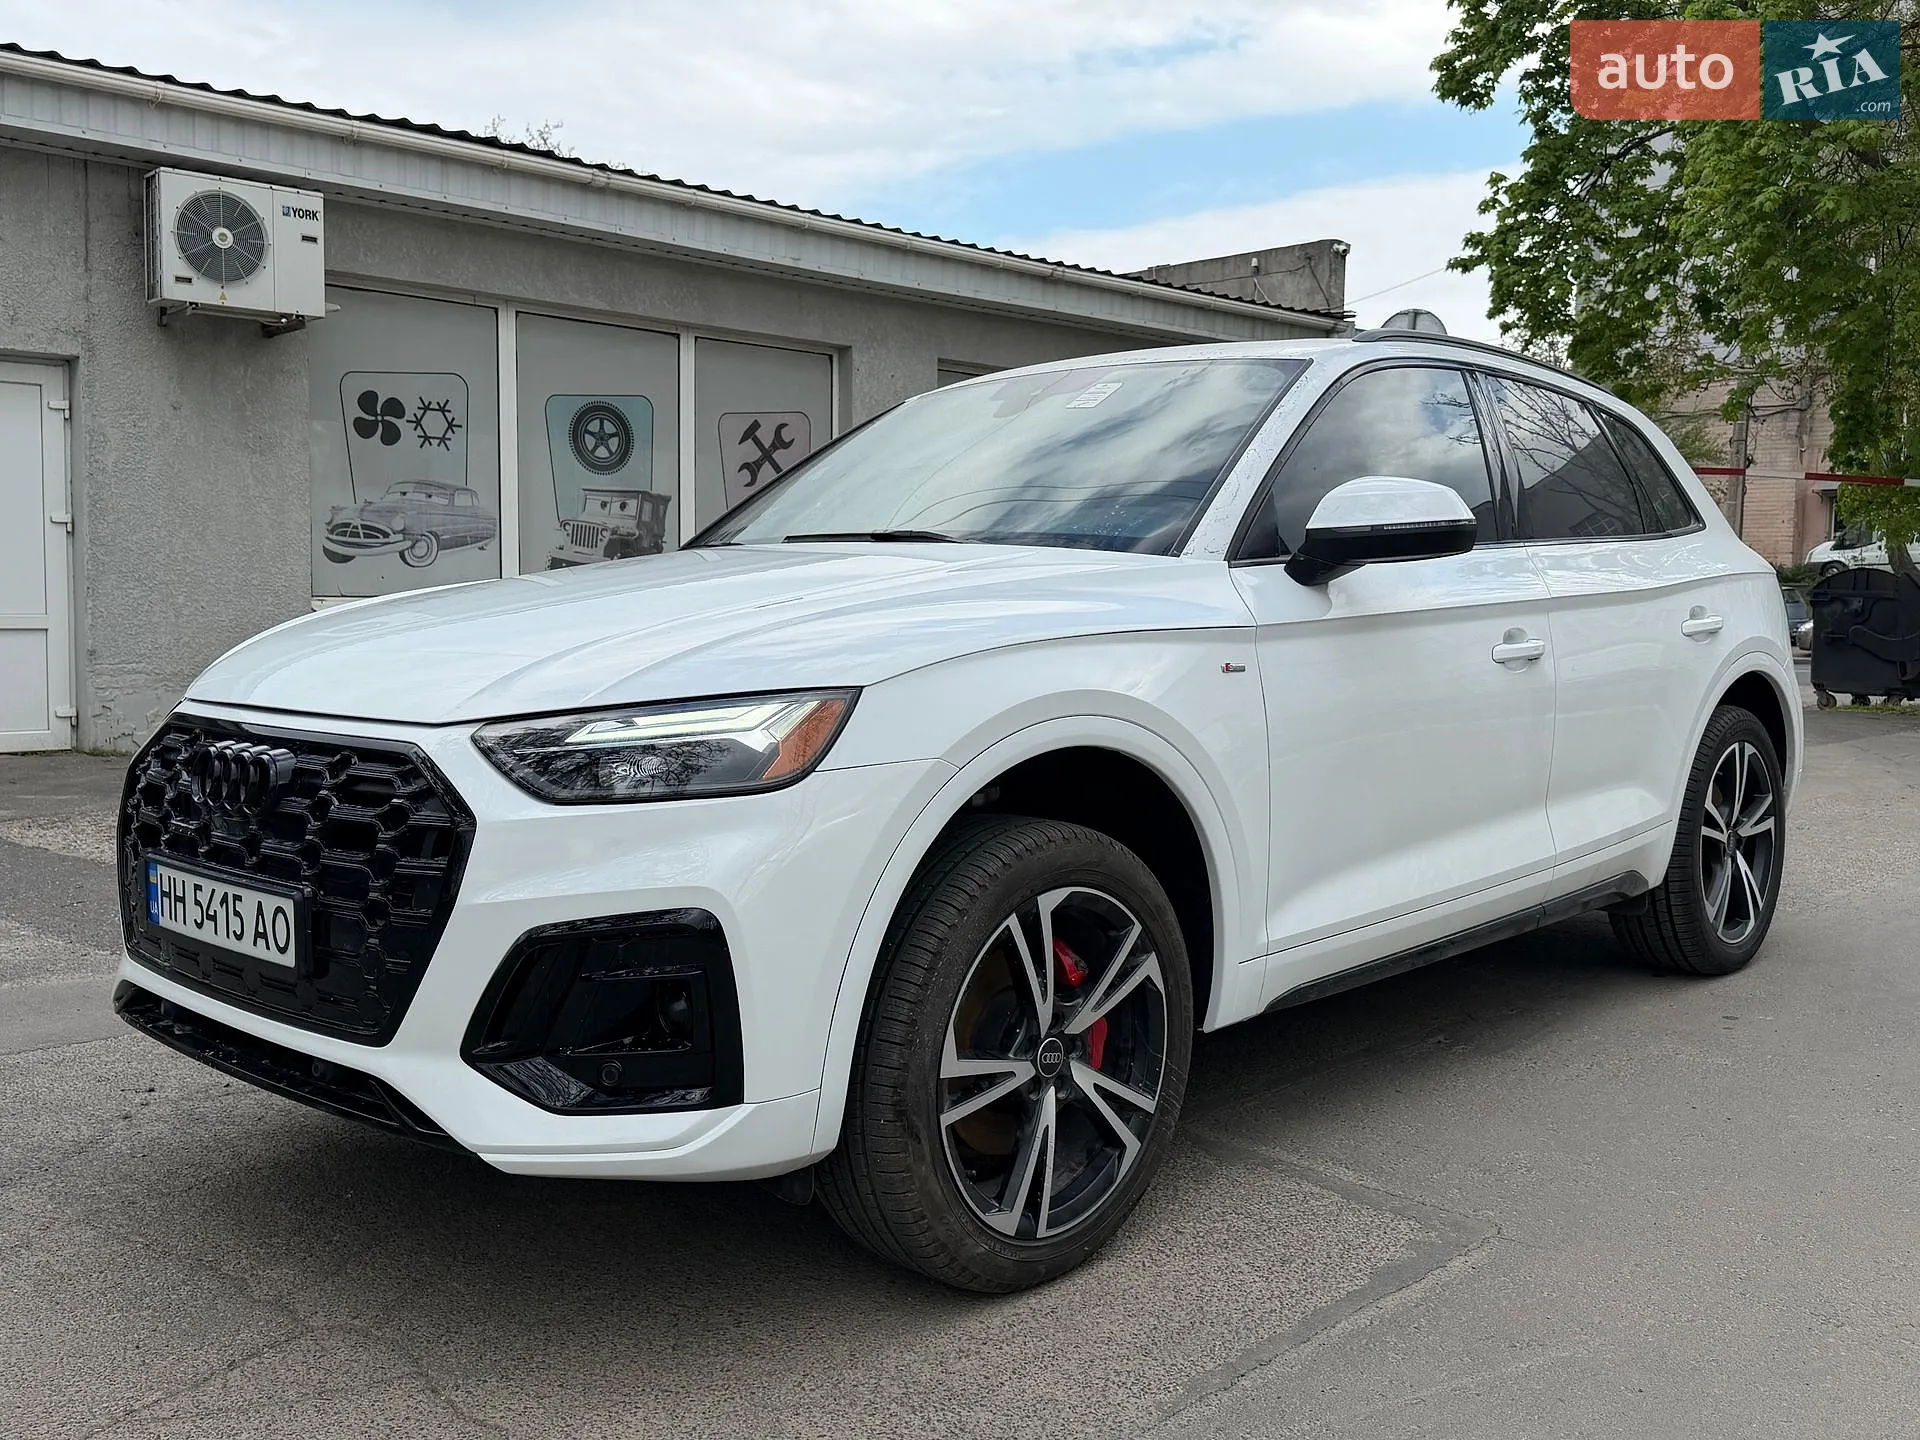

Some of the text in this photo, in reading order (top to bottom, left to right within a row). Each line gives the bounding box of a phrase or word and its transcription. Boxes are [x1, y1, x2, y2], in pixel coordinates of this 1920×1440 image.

[291, 206, 319, 221] YORK
[150, 899, 159, 916] UA
[159, 872, 291, 955] HH 5415 AO
